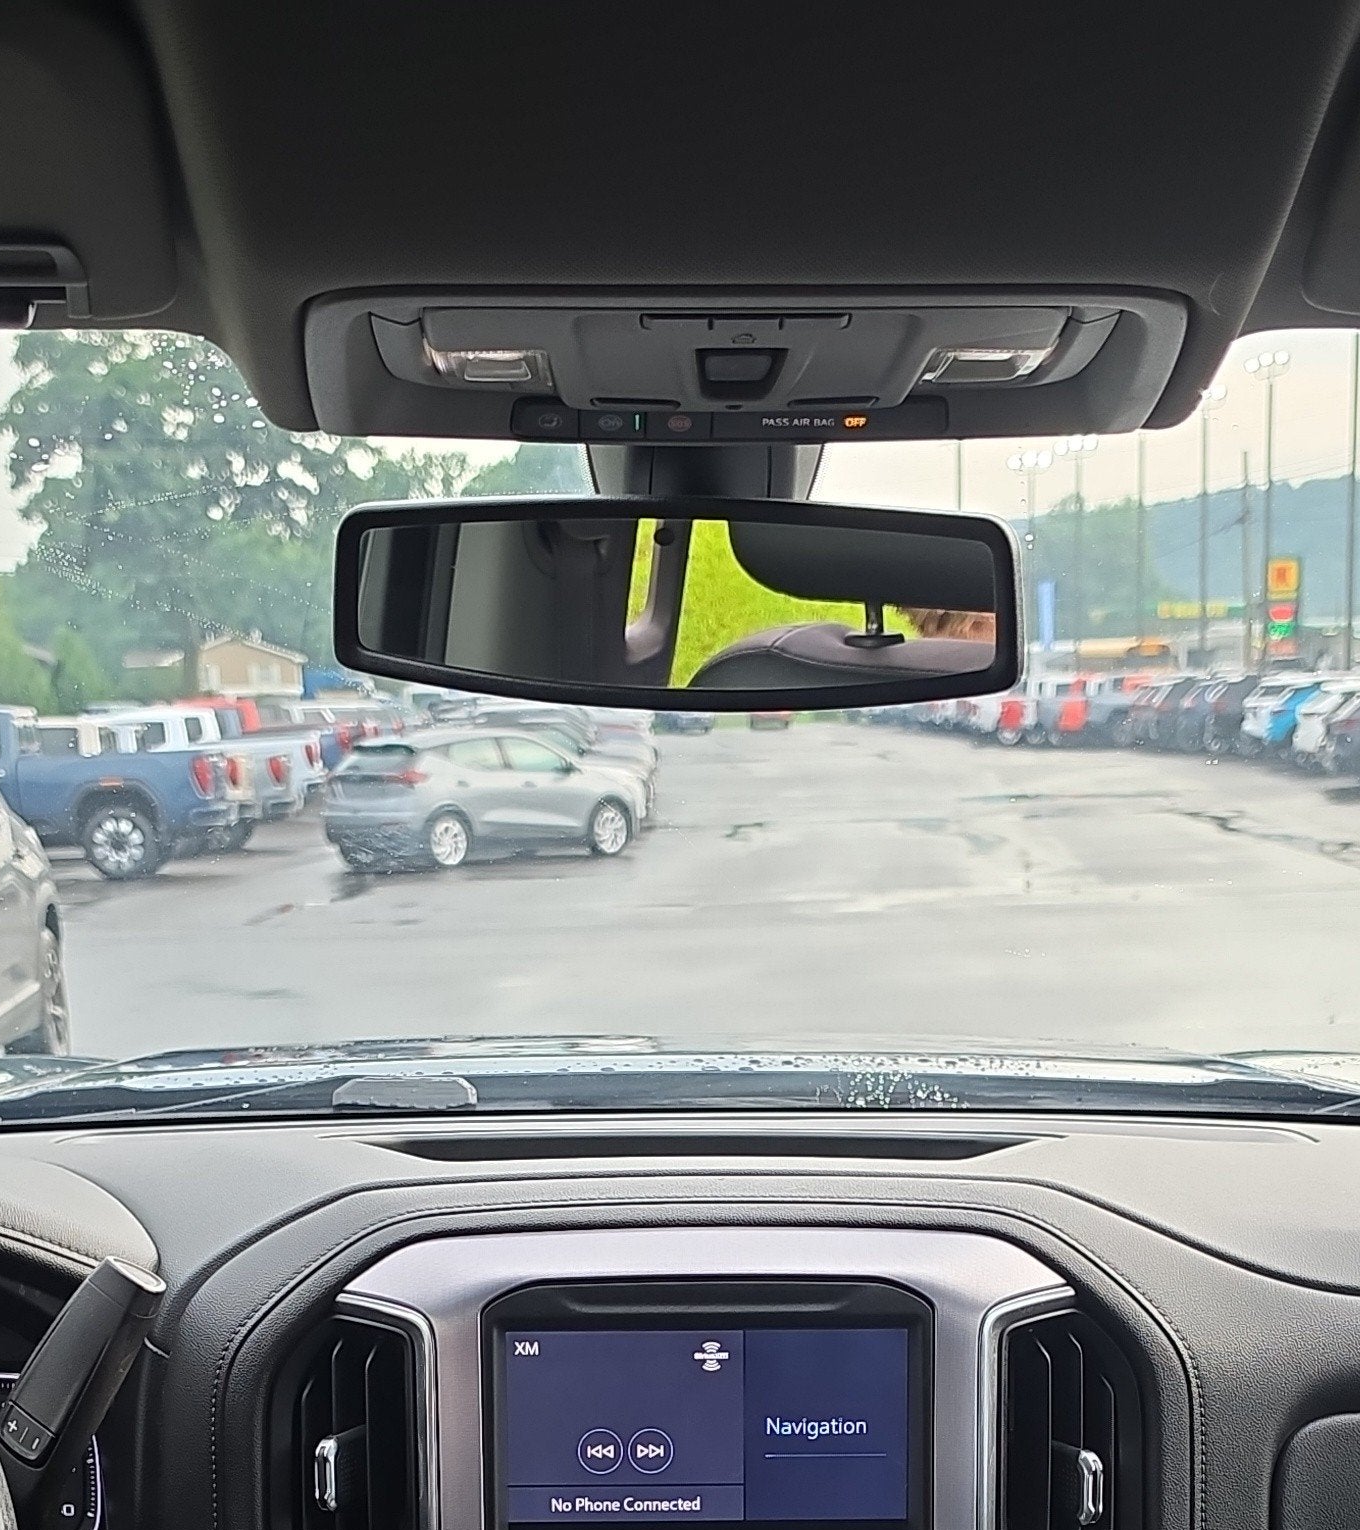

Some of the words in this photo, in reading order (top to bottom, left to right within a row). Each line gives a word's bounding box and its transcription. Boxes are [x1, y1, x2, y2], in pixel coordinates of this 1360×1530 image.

[762, 418, 790, 427] PASS
[792, 418, 810, 427] AIR
[813, 418, 835, 427] BAG
[843, 417, 867, 428] OFF
[514, 1341, 540, 1357] XM
[766, 1416, 868, 1440] Navigation
[550, 1497, 573, 1513] No
[576, 1497, 622, 1513] Phone
[623, 1496, 702, 1513] Connected
